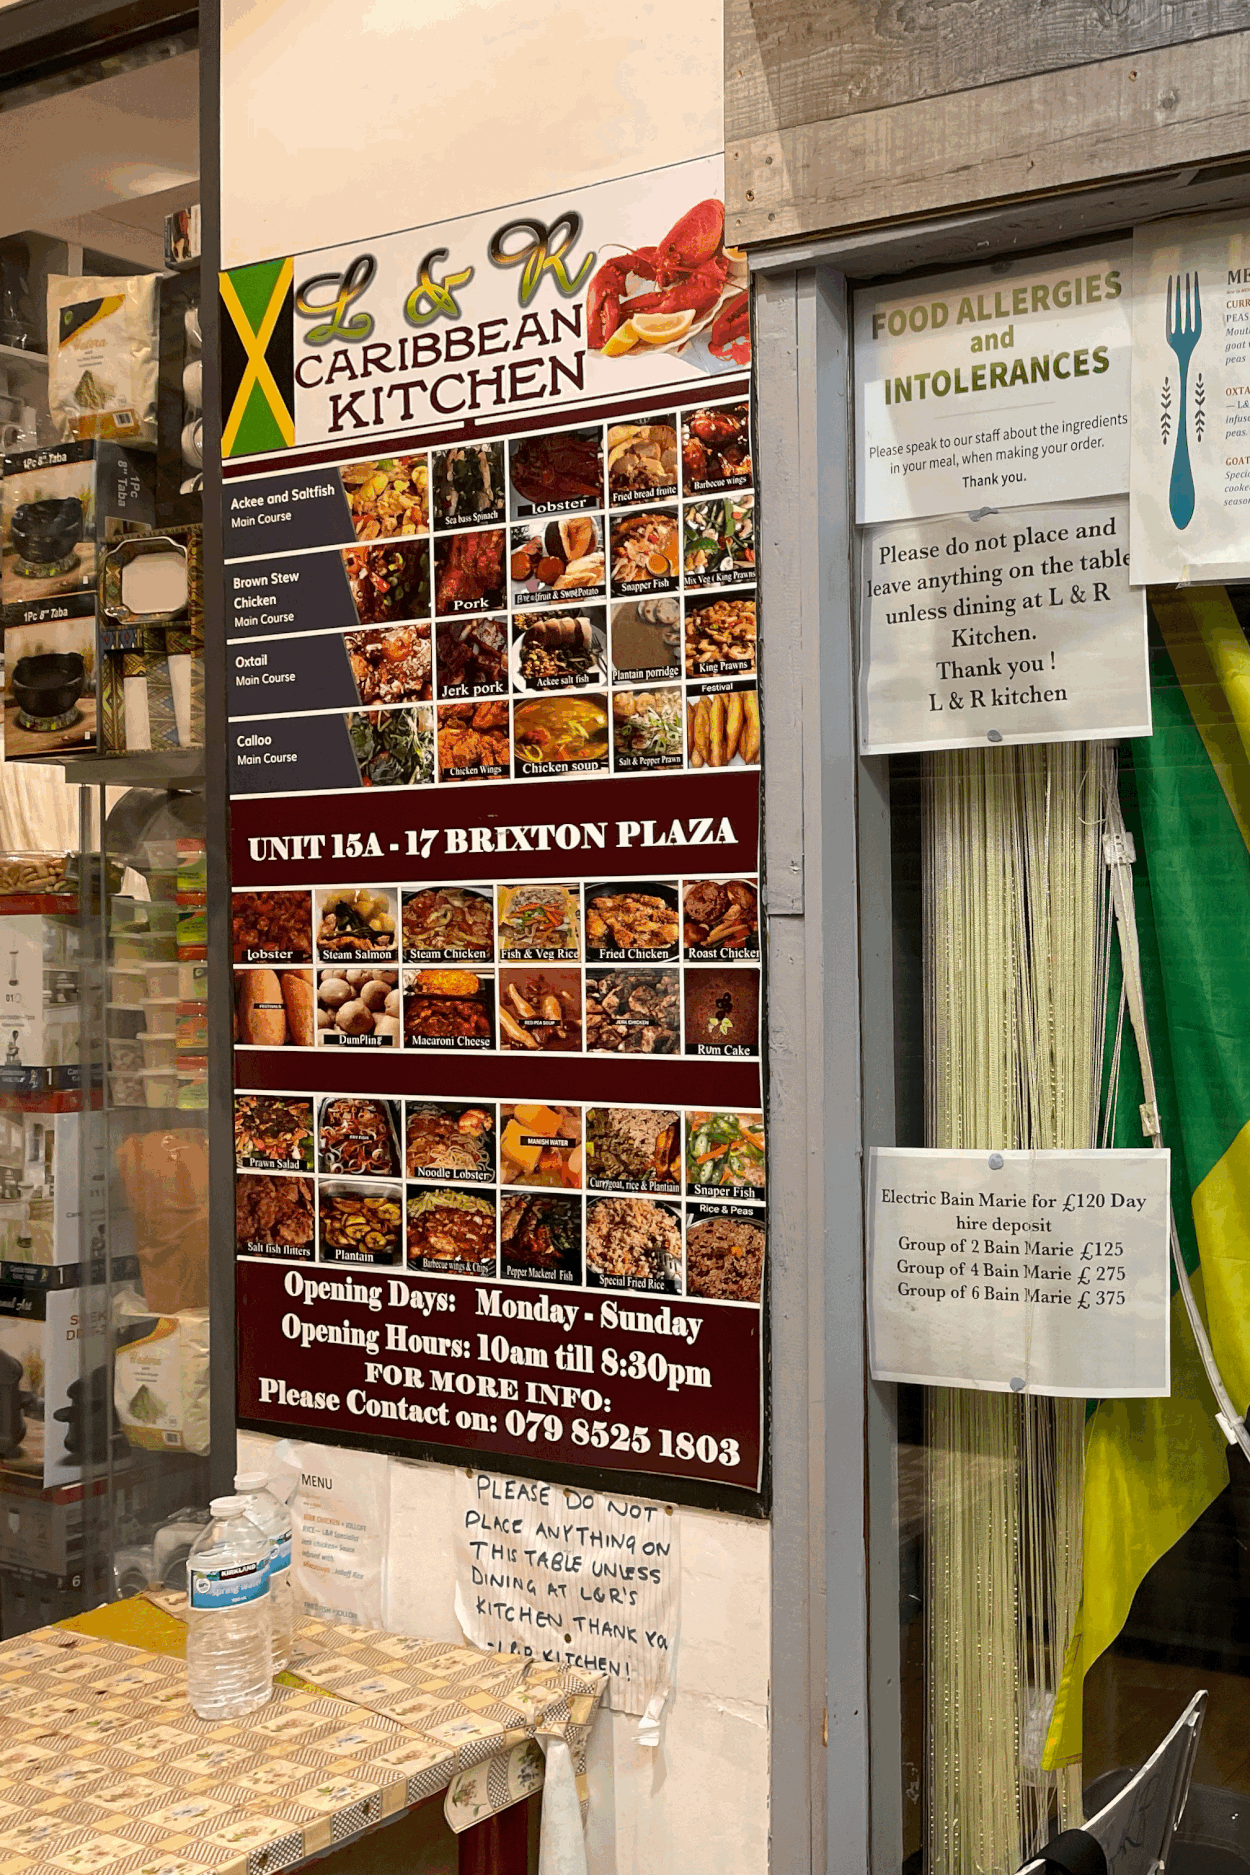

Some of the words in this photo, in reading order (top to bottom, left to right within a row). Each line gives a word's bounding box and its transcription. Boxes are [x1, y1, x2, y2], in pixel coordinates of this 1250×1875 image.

[295, 253, 377, 345] L
[404, 247, 474, 328] &
[488, 210, 594, 307] R
[872, 302, 949, 340] FOOD
[956, 270, 1122, 325] ALLERGIES
[295, 305, 582, 388] CARIBBEAN
[970, 324, 1014, 353] and
[885, 345, 1110, 405] INTOLERANCES
[327, 351, 586, 432] KITCHEN
[869, 444, 904, 458] Please
[905, 437, 937, 455] speak
[939, 435, 951, 448] to
[953, 433, 973, 447] our
[975, 428, 1000, 444] staff
[1002, 424, 1037, 441] about
[1039, 422, 1059, 435] the
[1062, 413, 1128, 435] ingredients
[890, 462, 900, 474] in
[902, 458, 927, 476] your
[929, 454, 960, 469] meal,
[962, 450, 993, 465] when
[996, 445, 1039, 461] making
[1041, 443, 1067, 458] your
[1070, 436, 1105, 451] order.
[962, 473, 998, 488] Thank
[1001, 471, 1026, 486] you.
[231, 496, 264, 510] Ackee
[267, 491, 289, 504] and
[292, 484, 335, 501] Saltfish
[231, 517, 255, 528] Main
[258, 511, 292, 525] Course
[879, 543, 940, 565] Please
[946, 537, 969, 556] do
[975, 533, 1007, 552] not
[1013, 526, 1069, 552] place
[1075, 517, 1117, 539] and
[233, 576, 268, 589] Brown
[271, 572, 299, 584] Stew
[867, 579, 911, 598] leave
[917, 564, 1003, 593] anything
[1009, 563, 1034, 579] on
[1040, 556, 1074, 575] the
[1080, 548, 1130, 571] table
[621, 581, 651, 592] Snapper
[653, 578, 669, 588] Fish
[50, 607, 69, 618] Taba
[234, 595, 277, 610] Chicken
[886, 603, 947, 625] unless
[953, 593, 1016, 617] dining
[1022, 592, 1043, 609] at
[1048, 588, 1064, 606] L
[1070, 585, 1087, 604] &
[1092, 582, 1111, 601] R
[234, 616, 258, 628] Main
[261, 612, 294, 625] Course
[951, 625, 1037, 648] Kitchen.
[235, 654, 268, 668] Oxtail
[236, 675, 260, 686] Main
[262, 672, 296, 684] Course
[237, 735, 272, 747] Calloo
[237, 754, 262, 766] Main
[263, 752, 298, 764] Course
[523, 761, 568, 774] Chicken
[571, 761, 599, 773] soup
[248, 834, 325, 862] UNIT
[332, 832, 385, 859] 15A
[389, 842, 399, 852] -
[405, 830, 440, 858] 17
[445, 822, 608, 854] BRIXTON
[616, 816, 738, 847] PLAZA
[323, 950, 352, 960] Steam
[355, 949, 392, 960] Salmon
[410, 949, 441, 959] Steam
[444, 948, 487, 959] Chicken
[599, 948, 627, 959] Fried
[629, 948, 669, 959] Chicken
[698, 1045, 721, 1056] Rum
[724, 1045, 751, 1056] Cake
[881, 1189, 936, 1206] Electric
[940, 1192, 975, 1207] Bain
[979, 1193, 1026, 1208] Marie
[1032, 1194, 1057, 1208] for
[1062, 1194, 1105, 1212] £120
[1110, 1193, 1147, 1212] Day
[956, 1215, 987, 1230] hire
[992, 1217, 1052, 1235] deposit
[899, 1237, 946, 1255] Group
[950, 1238, 967, 1253] of
[971, 1240, 980, 1253] 2
[984, 1240, 1020, 1255] Bain
[1025, 1242, 1074, 1257] Marie
[1079, 1241, 1124, 1261] £125
[284, 1270, 384, 1310] Opening
[389, 1280, 456, 1314] Days:
[476, 1288, 579, 1331] Monday
[584, 1312, 595, 1321] -
[600, 1299, 703, 1345] Sunday
[281, 1312, 380, 1354] Opening
[385, 1323, 471, 1359] Hours:
[478, 1333, 548, 1369] 10am
[555, 1343, 595, 1374] till
[600, 1347, 712, 1391] 8:30pm
[364, 1361, 425, 1389] FOR
[430, 1370, 519, 1399] MORE
[525, 1383, 612, 1413] INFO:
[259, 1377, 340, 1412] Please
[347, 1389, 450, 1425] Contact
[455, 1406, 498, 1432] on:
[505, 1409, 564, 1445] 079
[571, 1418, 652, 1454] 8525
[659, 1430, 741, 1467] 1803
[477, 1474, 550, 1506] PLEASE
[565, 1489, 594, 1510] DO
[608, 1500, 657, 1522] NOT
[221, 1563, 257, 1577] KIRKLAND
[469, 1541, 517, 1562] THIS
[524, 1549, 583, 1573] TABLE
[592, 1560, 661, 1584] UNLESS
